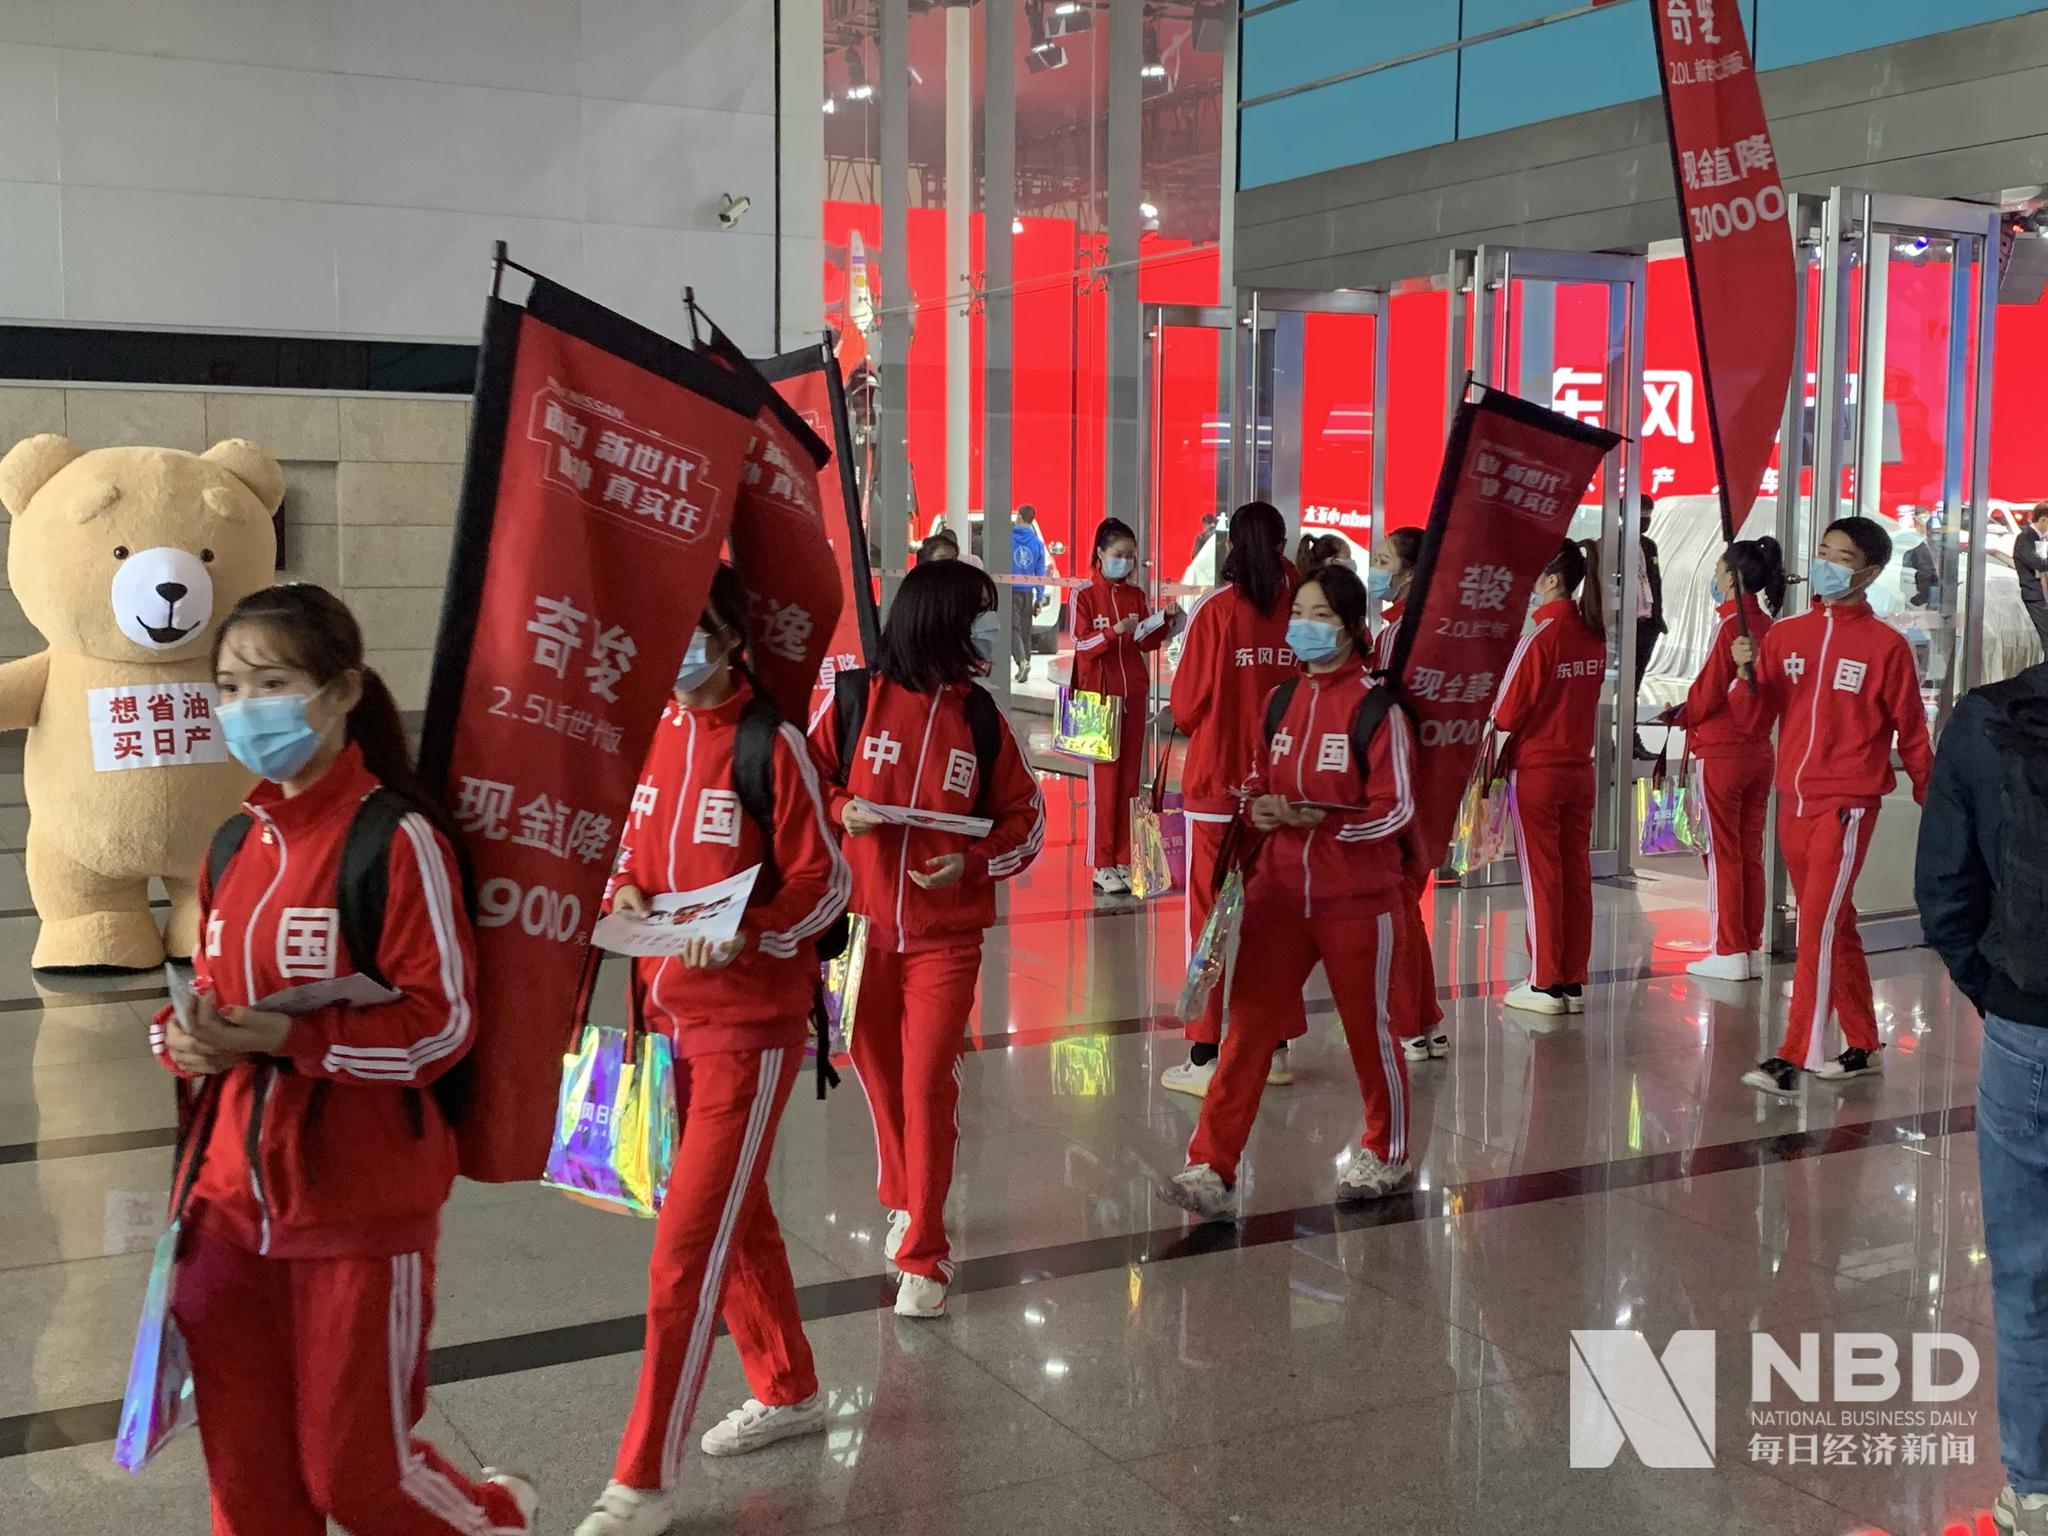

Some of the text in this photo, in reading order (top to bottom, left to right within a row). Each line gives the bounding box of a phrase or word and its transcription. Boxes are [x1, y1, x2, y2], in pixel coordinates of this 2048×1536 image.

[1682, 134, 1774, 190] 现金直降
[1690, 185, 1786, 243] 30000
[594, 430, 695, 492] 新世代
[603, 472, 702, 534] 真实在
[1234, 646, 1299, 668] 东风日
[1783, 651, 1868, 695] 中国
[109, 691, 211, 725] 想省油
[112, 726, 212, 761] 买日产
[862, 729, 978, 799] 中国
[1270, 726, 1350, 774] 中国
[630, 774, 744, 848] 中国
